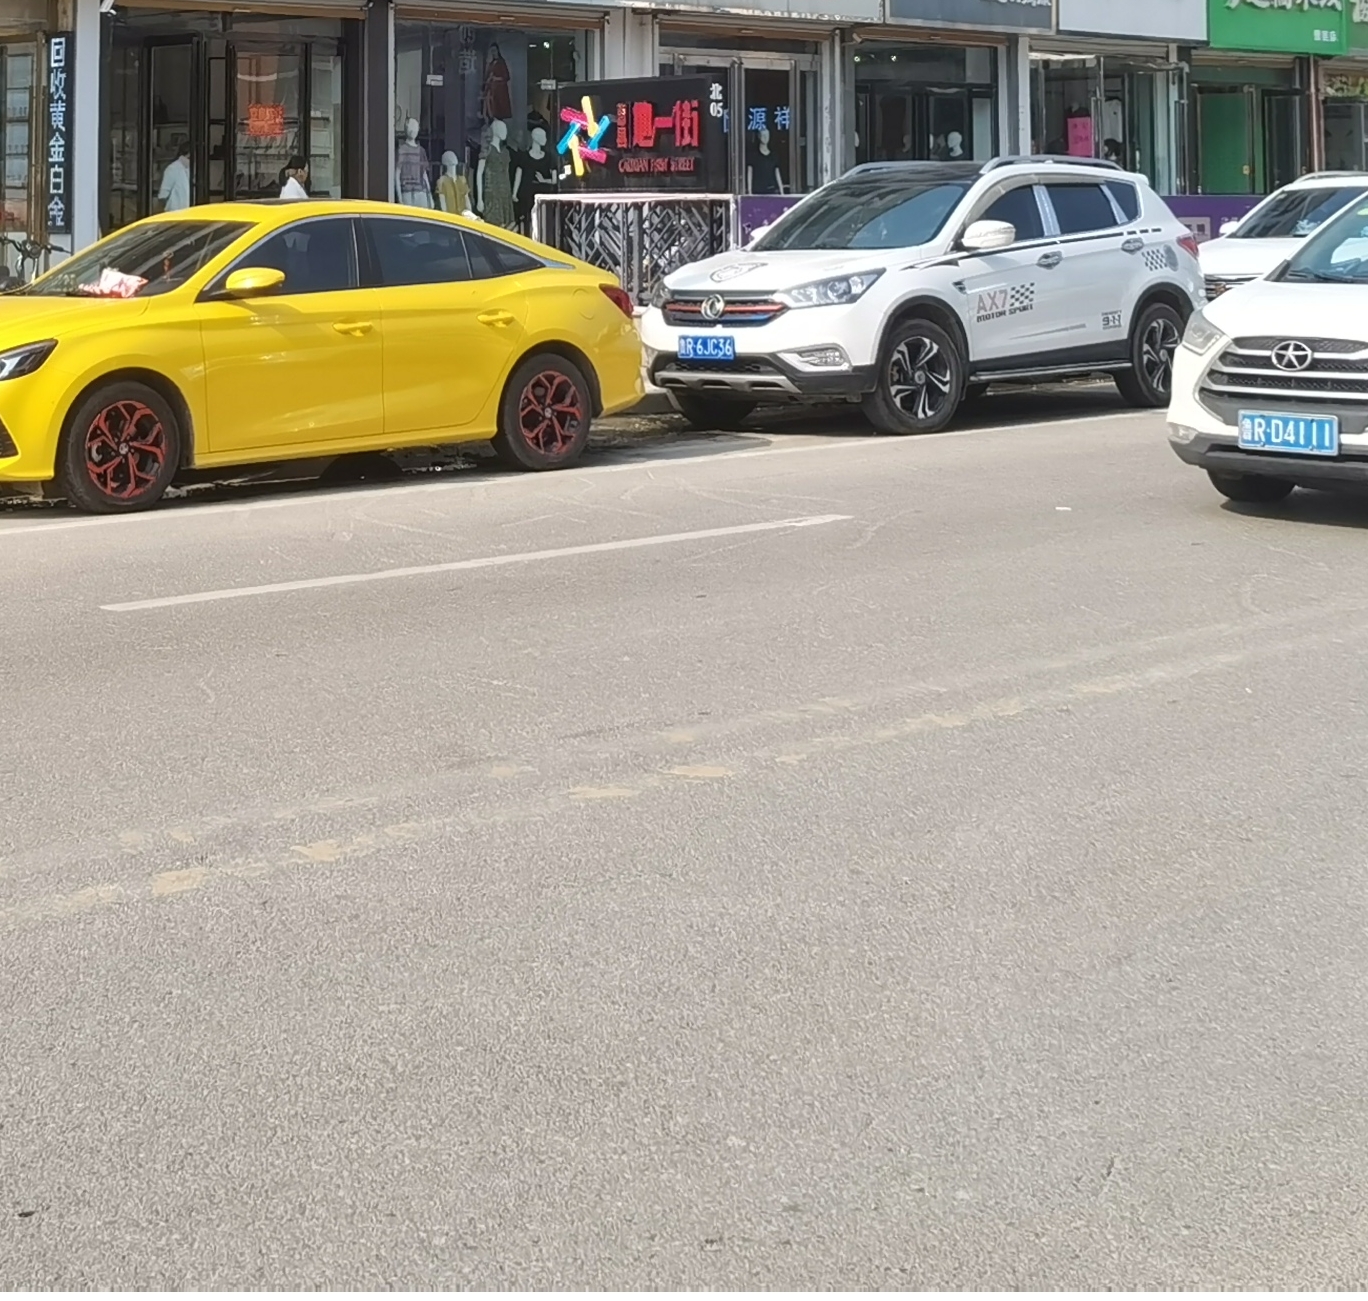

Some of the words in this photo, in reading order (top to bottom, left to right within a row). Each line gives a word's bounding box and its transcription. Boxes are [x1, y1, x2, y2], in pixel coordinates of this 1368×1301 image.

[710, 83, 723, 100] 北
[710, 102, 723, 118] 05
[977, 289, 1009, 314] AX7
[977, 310, 1007, 323] MOTOR
